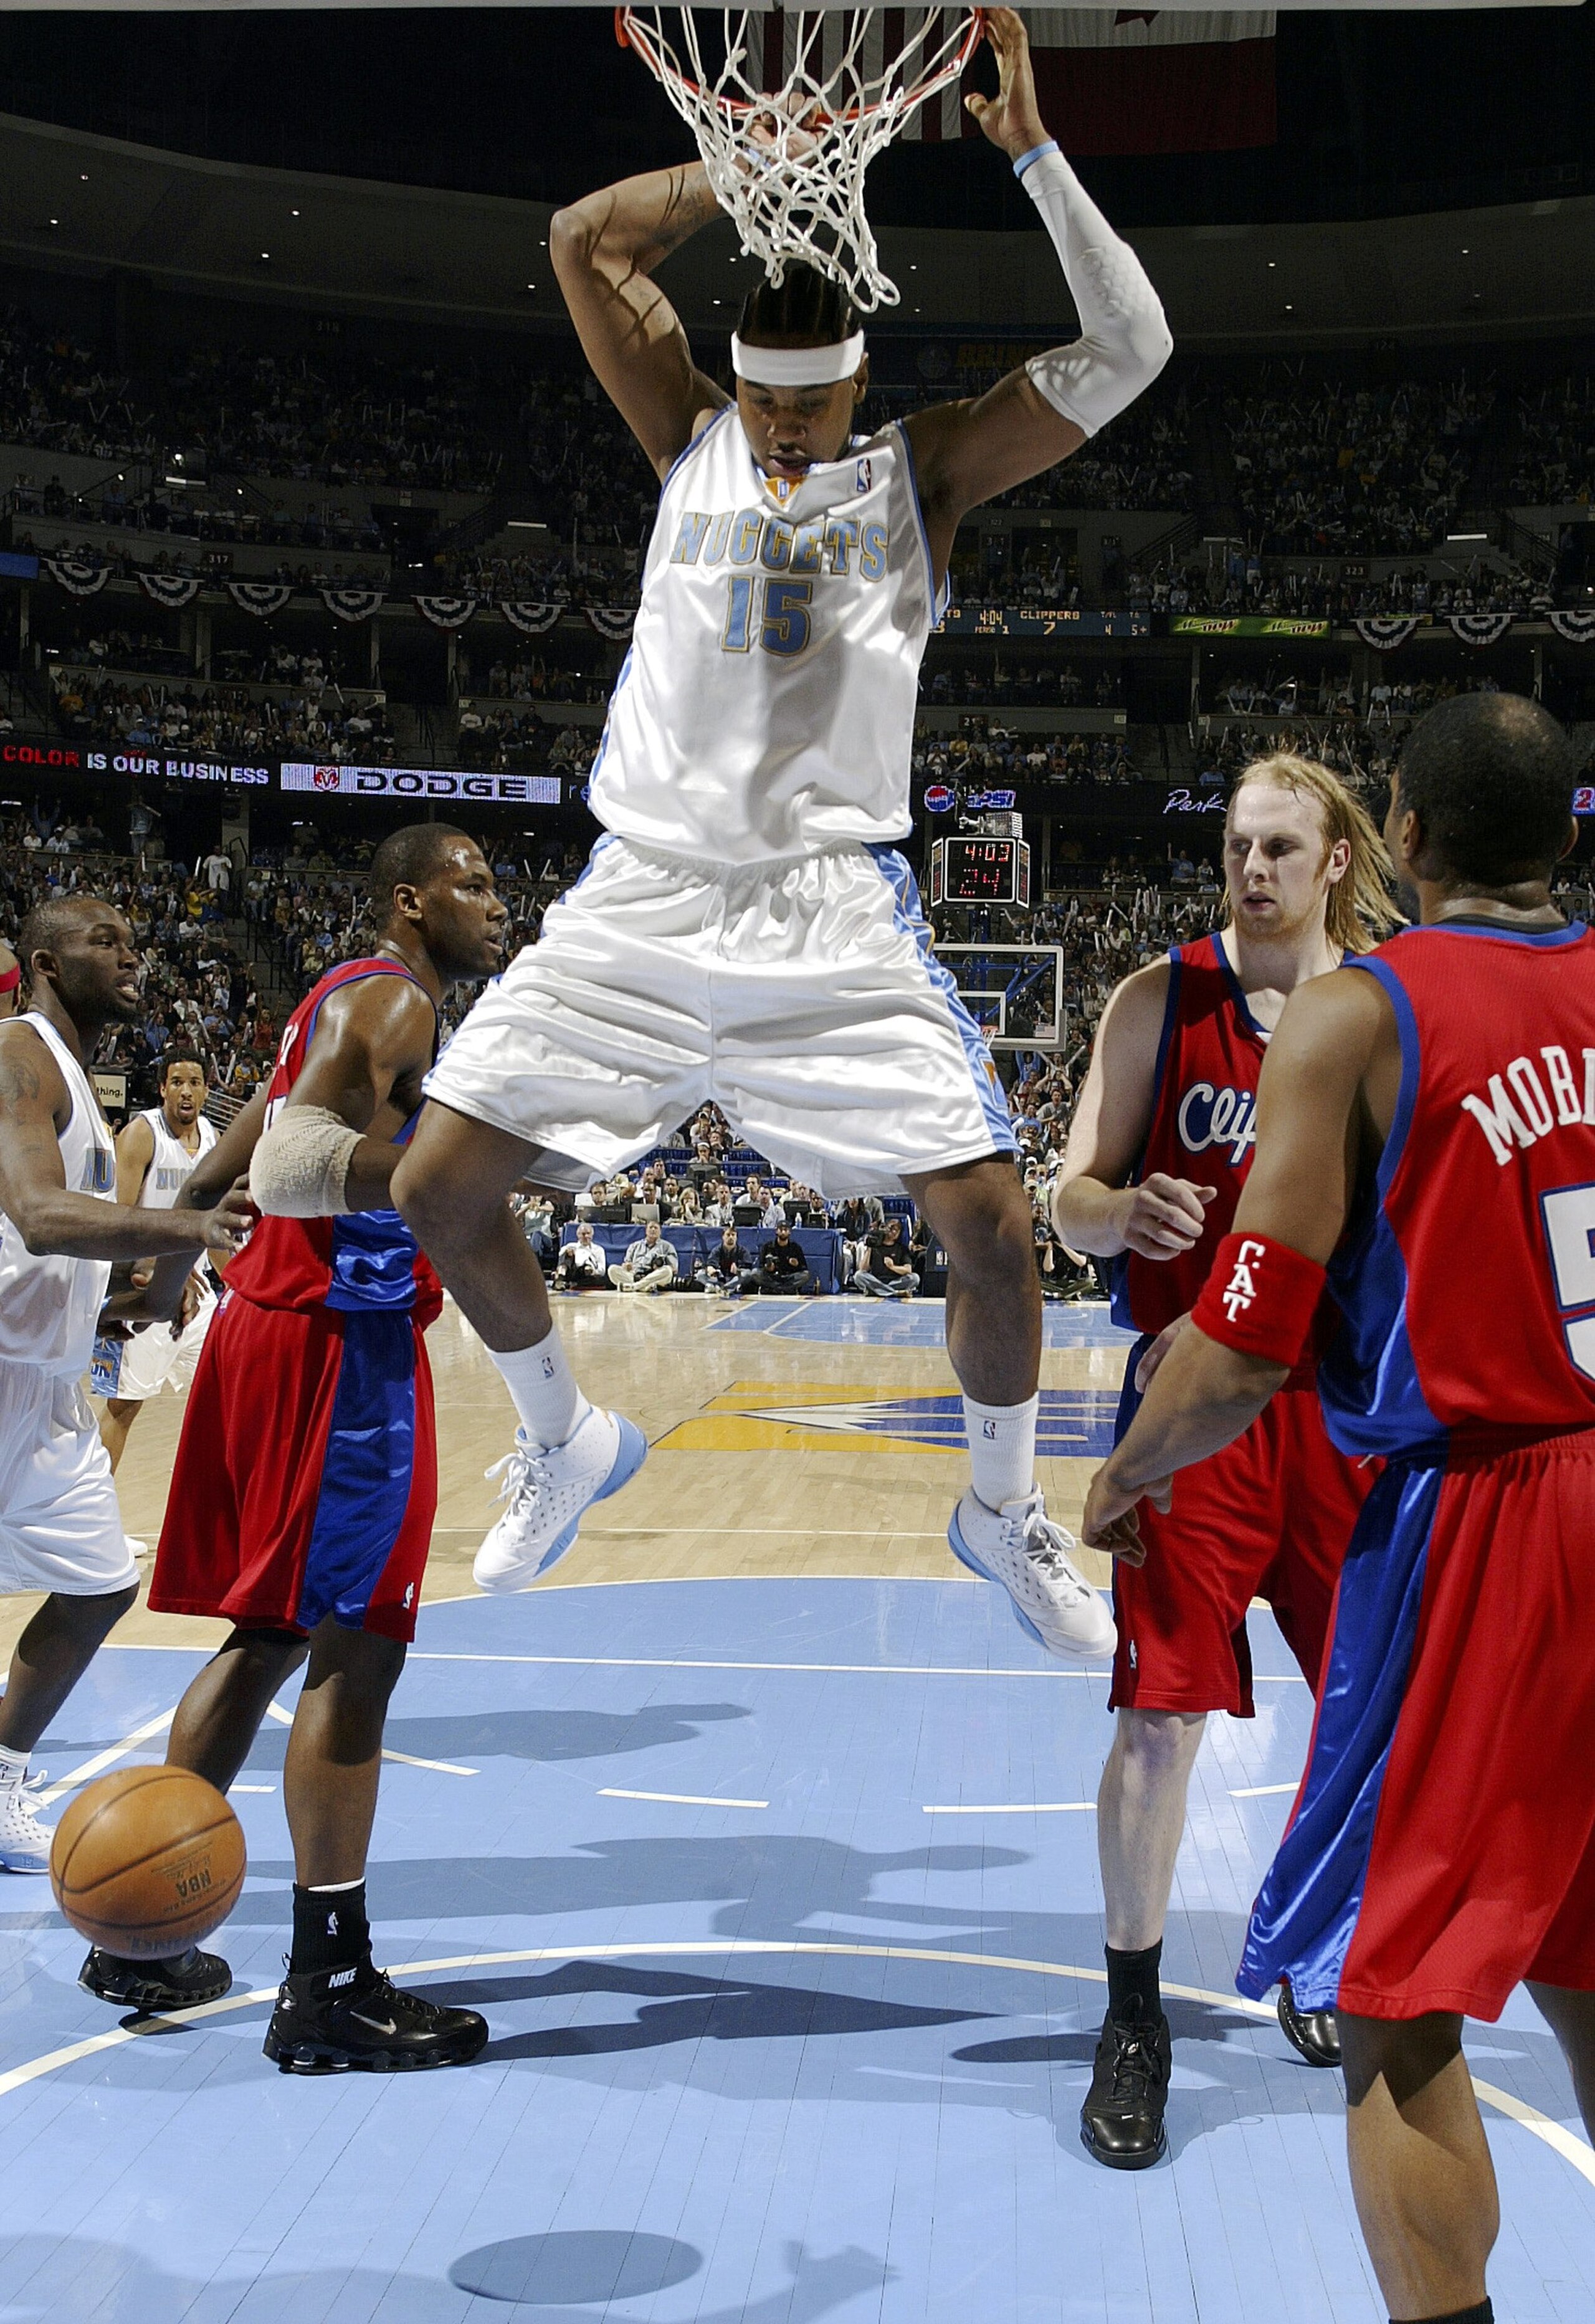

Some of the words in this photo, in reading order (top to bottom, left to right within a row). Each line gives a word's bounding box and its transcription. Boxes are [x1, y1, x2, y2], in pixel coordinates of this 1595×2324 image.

[670, 507, 890, 583] NUGGETS
[721, 574, 812, 657] 15
[979, 609, 1002, 626] 4:04
[1019, 611, 1080, 621] CLIPPERS
[1043, 622, 1055, 635] 7
[1105, 624, 1112, 636] 4
[2, 745, 80, 768] COLOR
[87, 752, 107, 770] IS
[113, 755, 160, 775] OUR
[166, 760, 269, 785] BUSINESS
[356, 771, 527, 800] DODGE
[965, 844, 1010, 862] 4:03
[959, 869, 1000, 896] 24
[175, 1868, 212, 1897] NBA
[328, 1967, 358, 1989] NIKE
